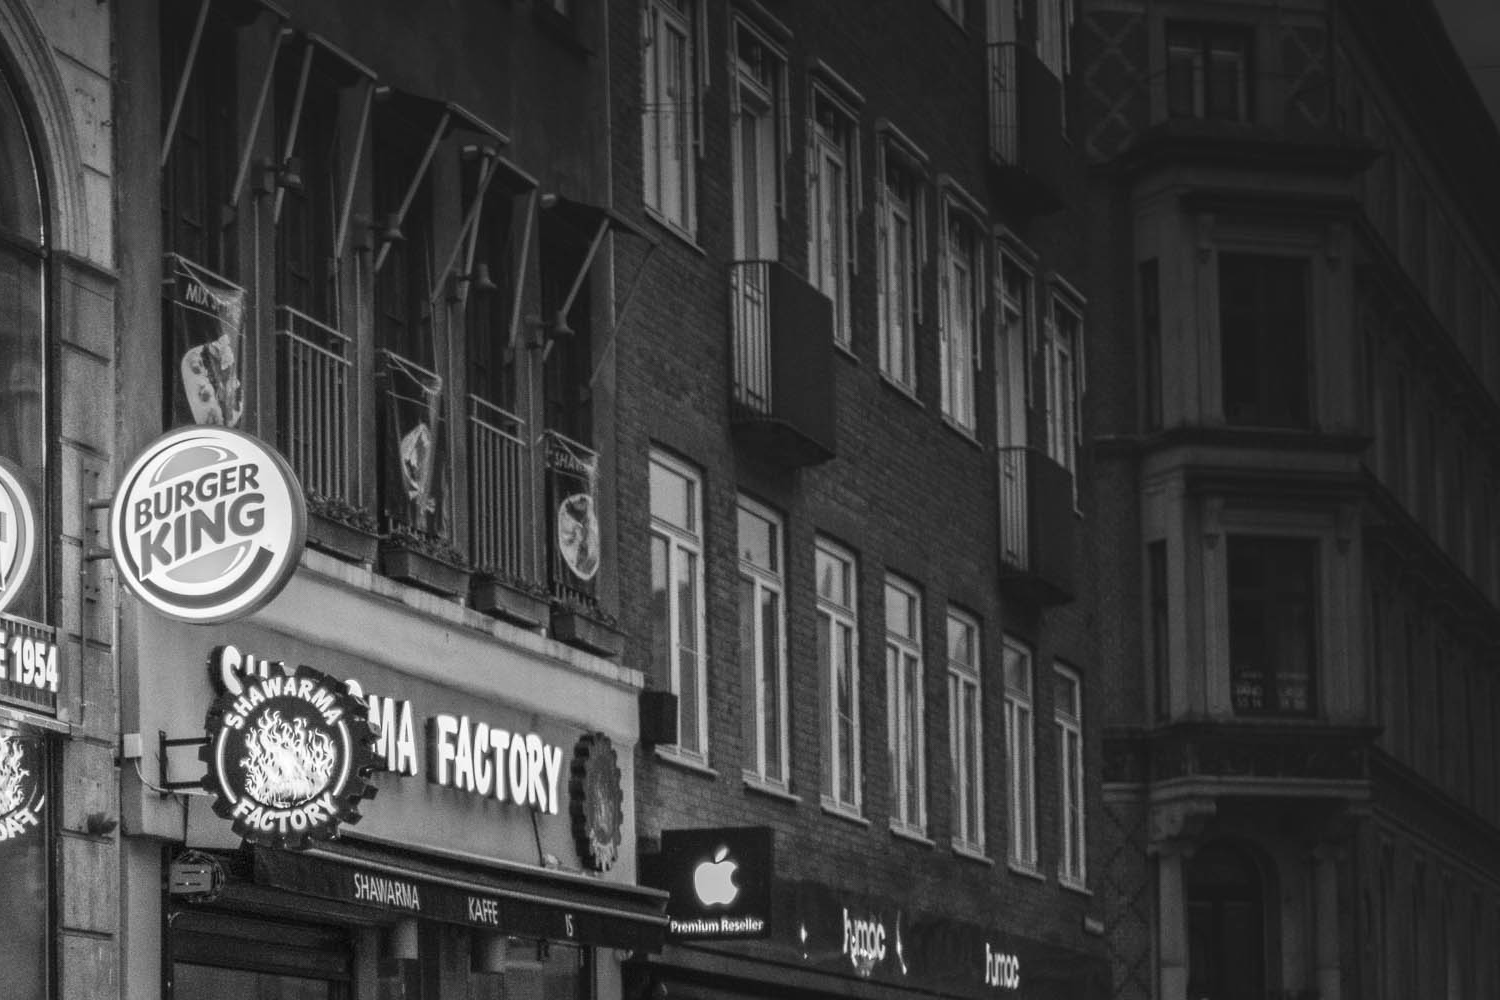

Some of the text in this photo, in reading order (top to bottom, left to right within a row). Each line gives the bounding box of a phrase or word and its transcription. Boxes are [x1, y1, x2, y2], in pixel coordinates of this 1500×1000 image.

[134, 463, 260, 534] BURGER
[139, 492, 265, 578] KING
[11, 636, 58, 692] 1954
[225, 676, 343, 730] SHAWARMA
[437, 715, 563, 816] FACTORY
[232, 791, 337, 833] FACTORY
[353, 872, 574, 937] SHAWARMA KAFFE IS
[670, 918, 764, 933] Premium Reseller
[986, 942, 1019, 989] humac
